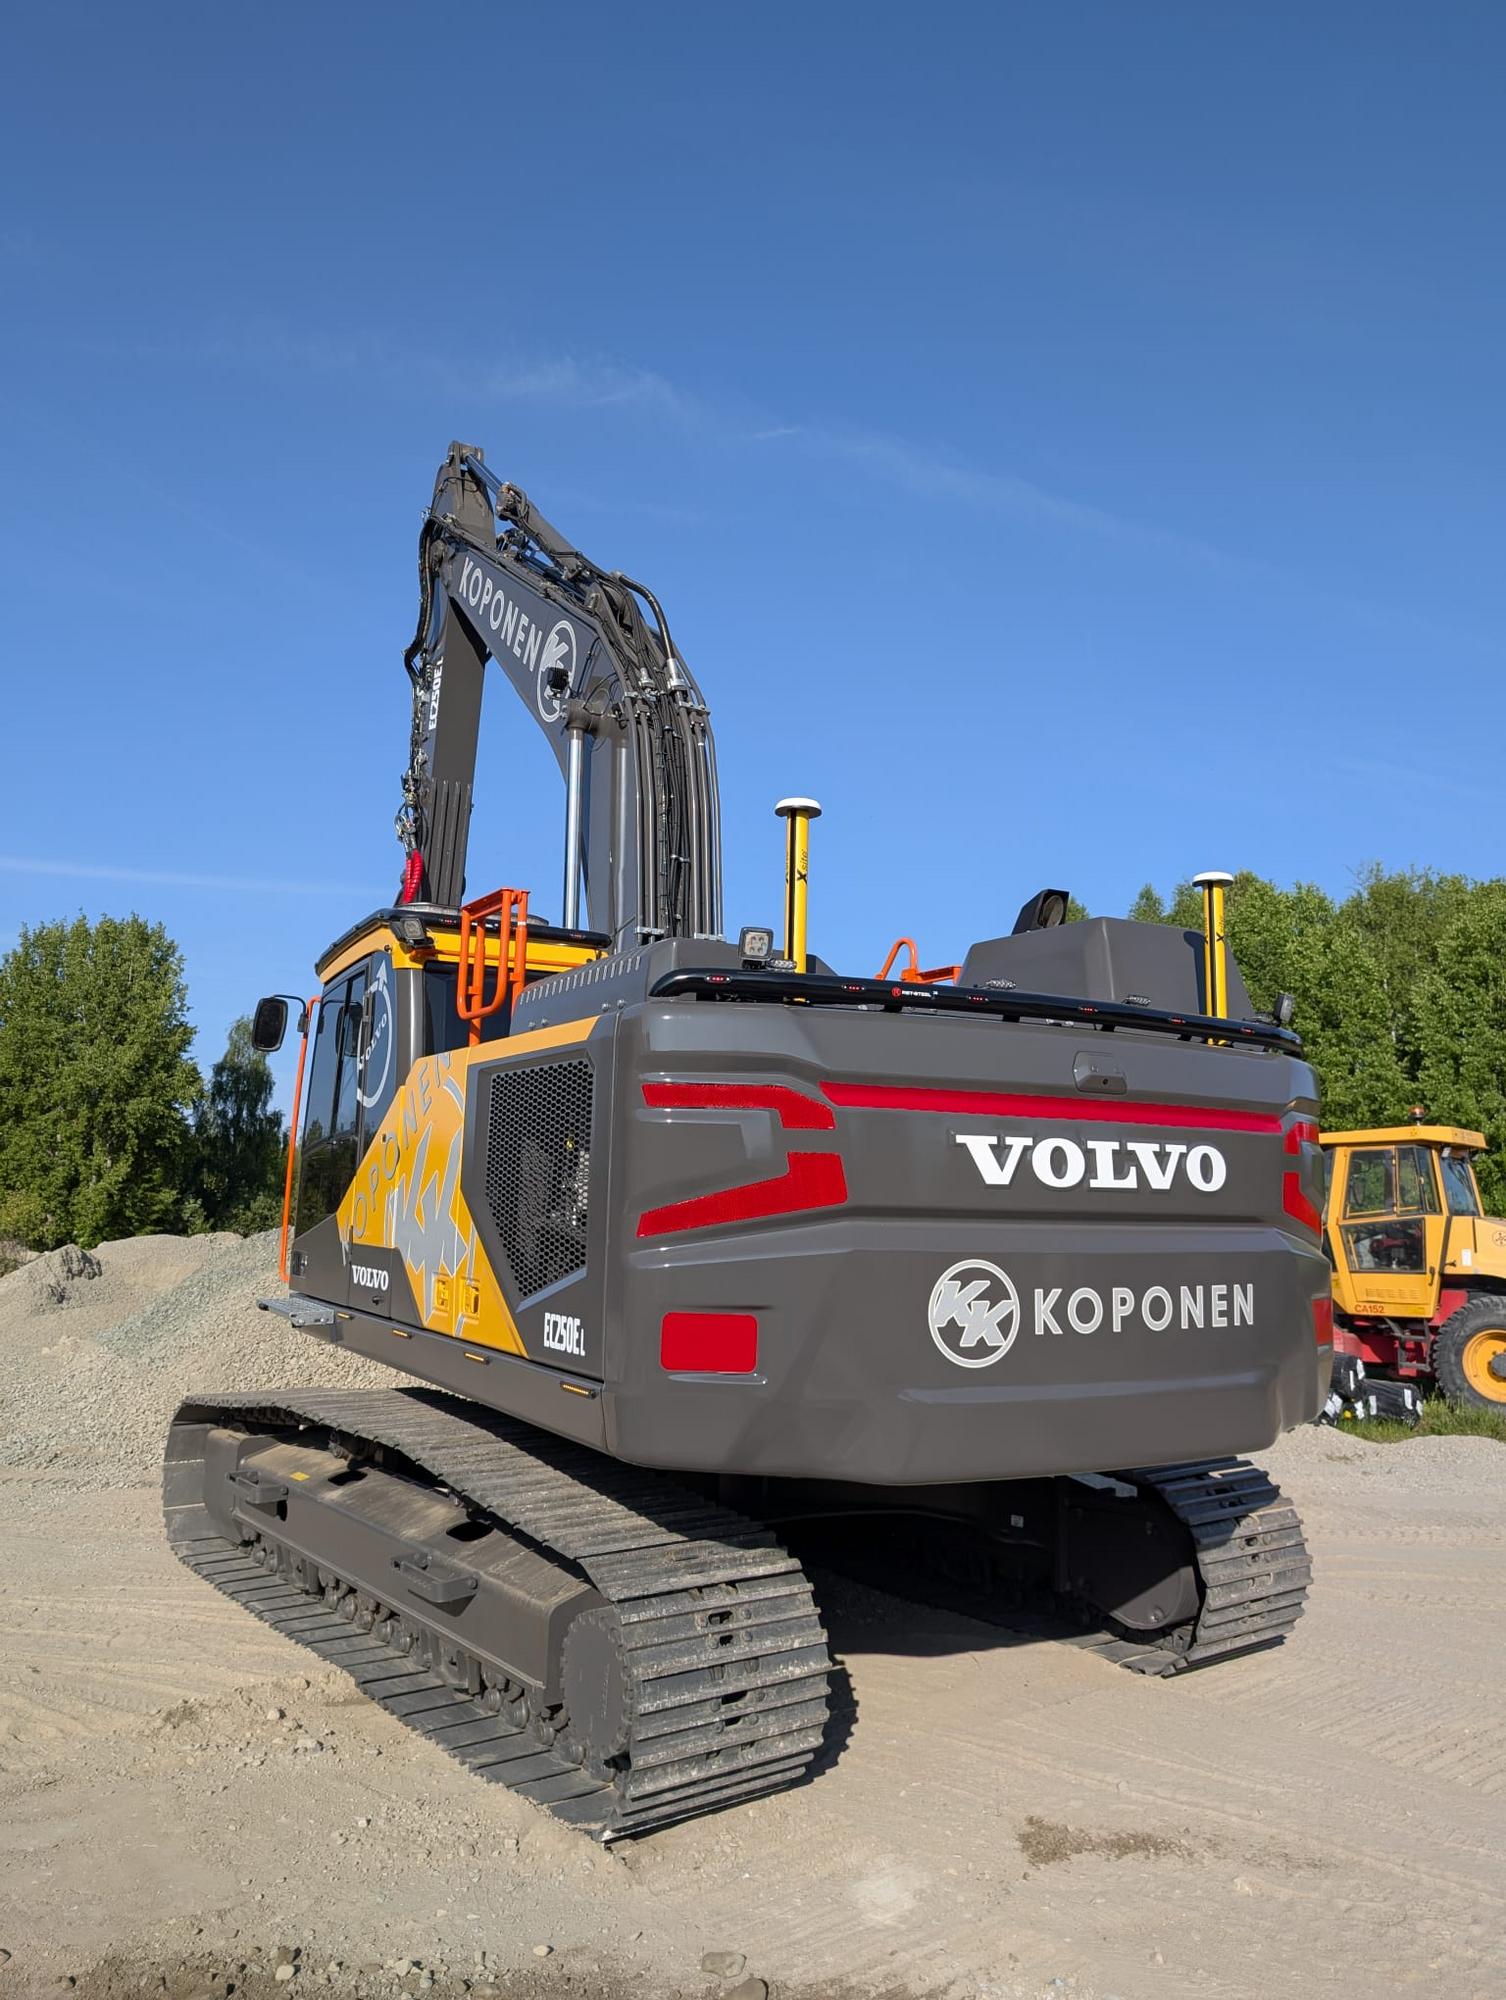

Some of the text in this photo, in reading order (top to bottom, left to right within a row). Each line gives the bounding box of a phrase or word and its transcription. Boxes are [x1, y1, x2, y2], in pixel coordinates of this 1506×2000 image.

[459, 556, 542, 672] KOPONEN
[955, 1134, 1227, 1192] VOLVO
[352, 1264, 389, 1291] VOLVO
[1034, 1283, 1254, 1335] KOPONEN
[1354, 1304, 1385, 1314] CA152
